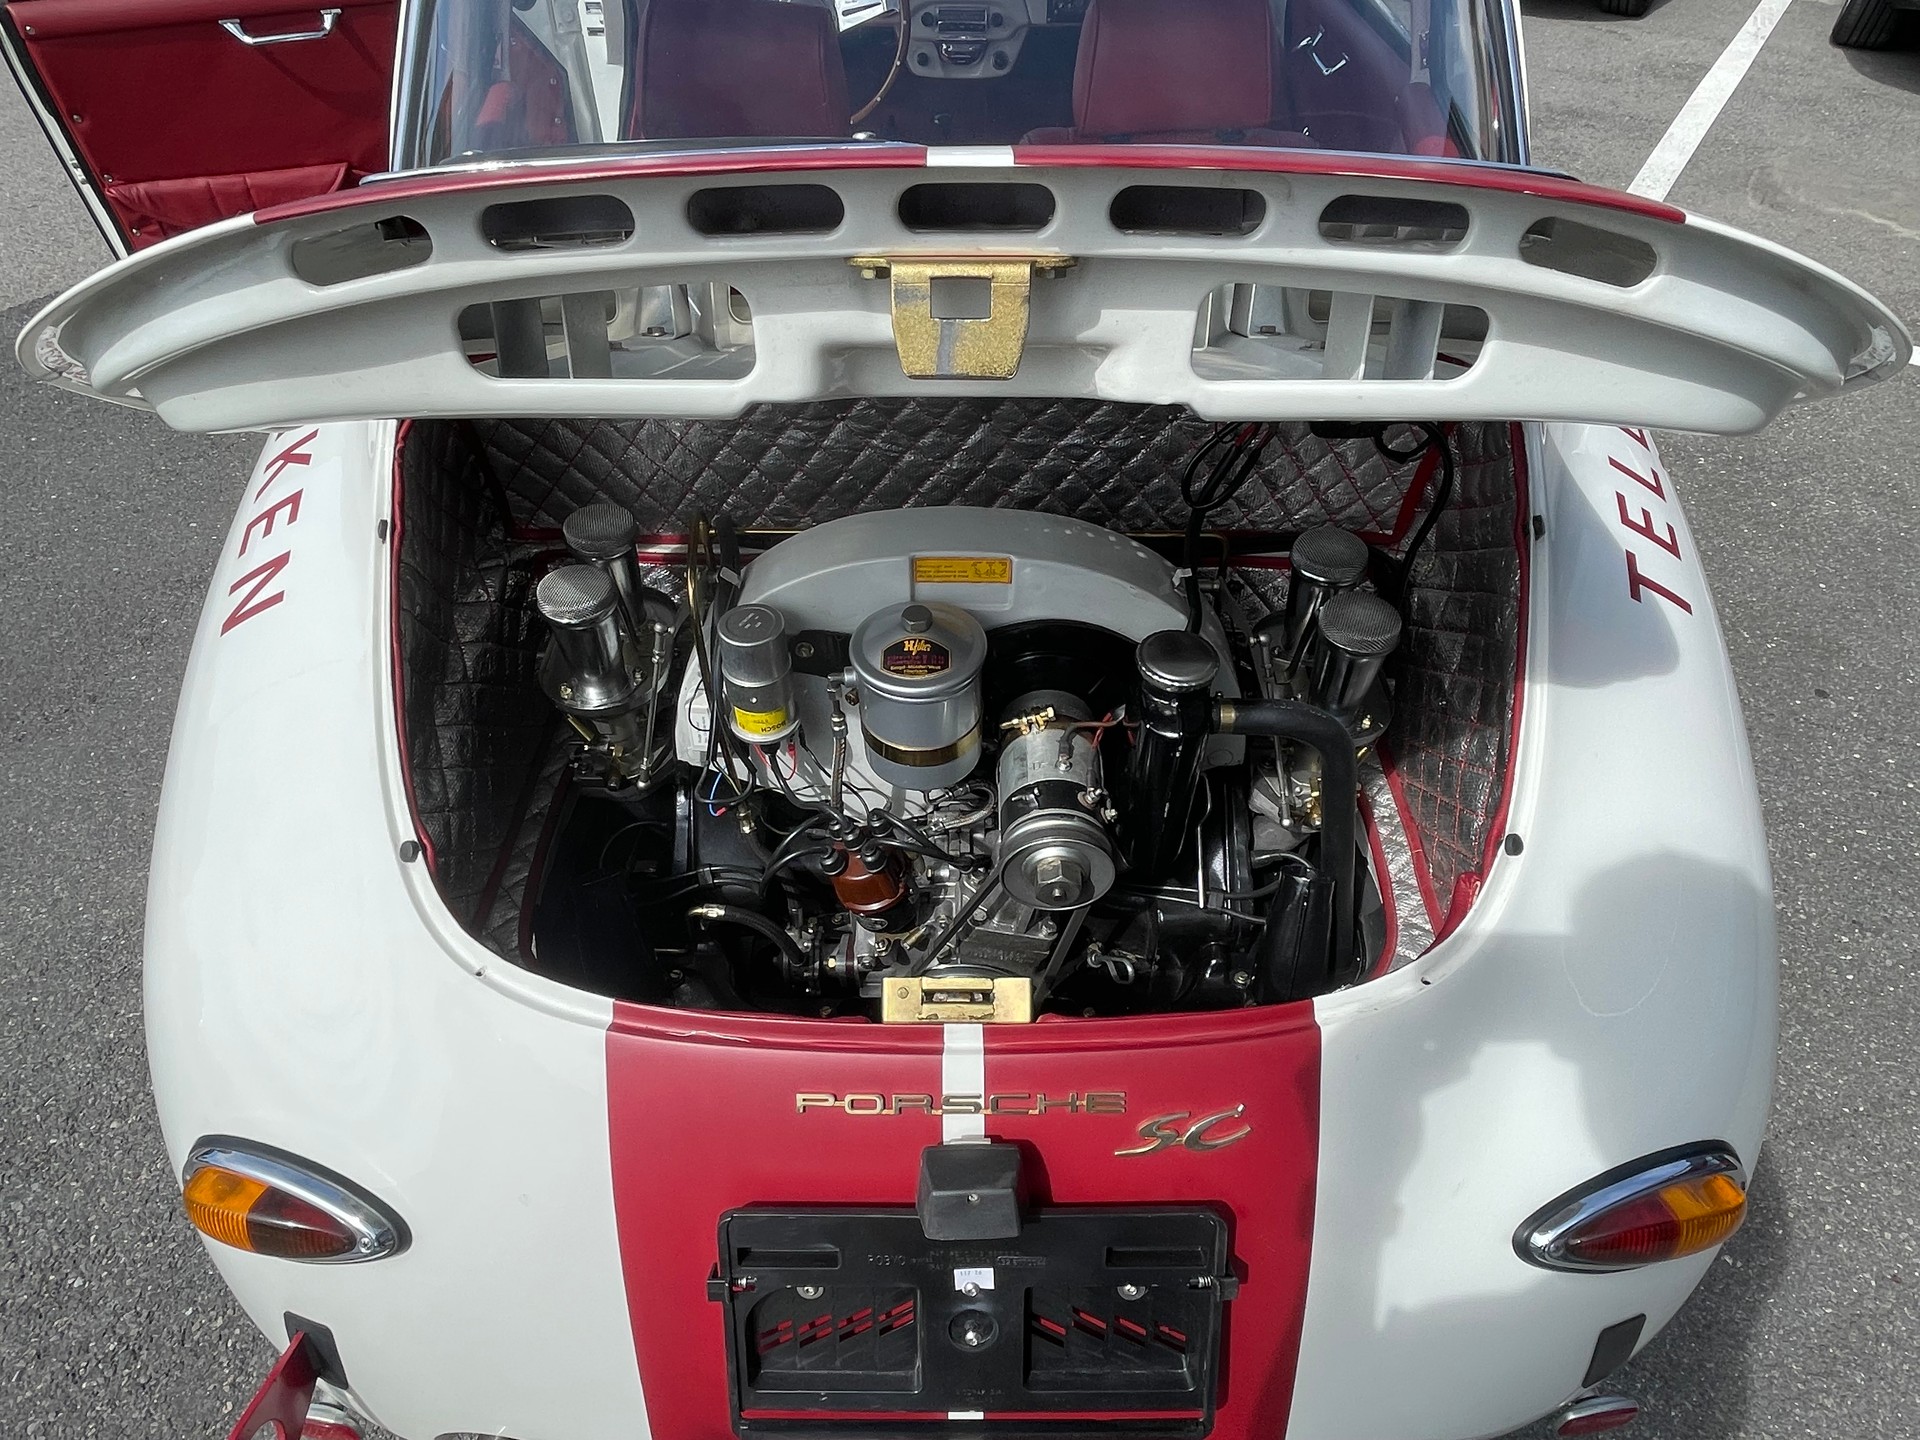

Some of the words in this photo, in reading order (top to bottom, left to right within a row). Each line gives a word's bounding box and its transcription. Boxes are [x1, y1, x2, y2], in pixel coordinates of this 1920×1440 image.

[220, 428, 319, 637] KEN
[760, 719, 787, 733] BOSCH
[795, 1092, 1127, 1115] PORSCHE
[1114, 1102, 1253, 1157] SC
